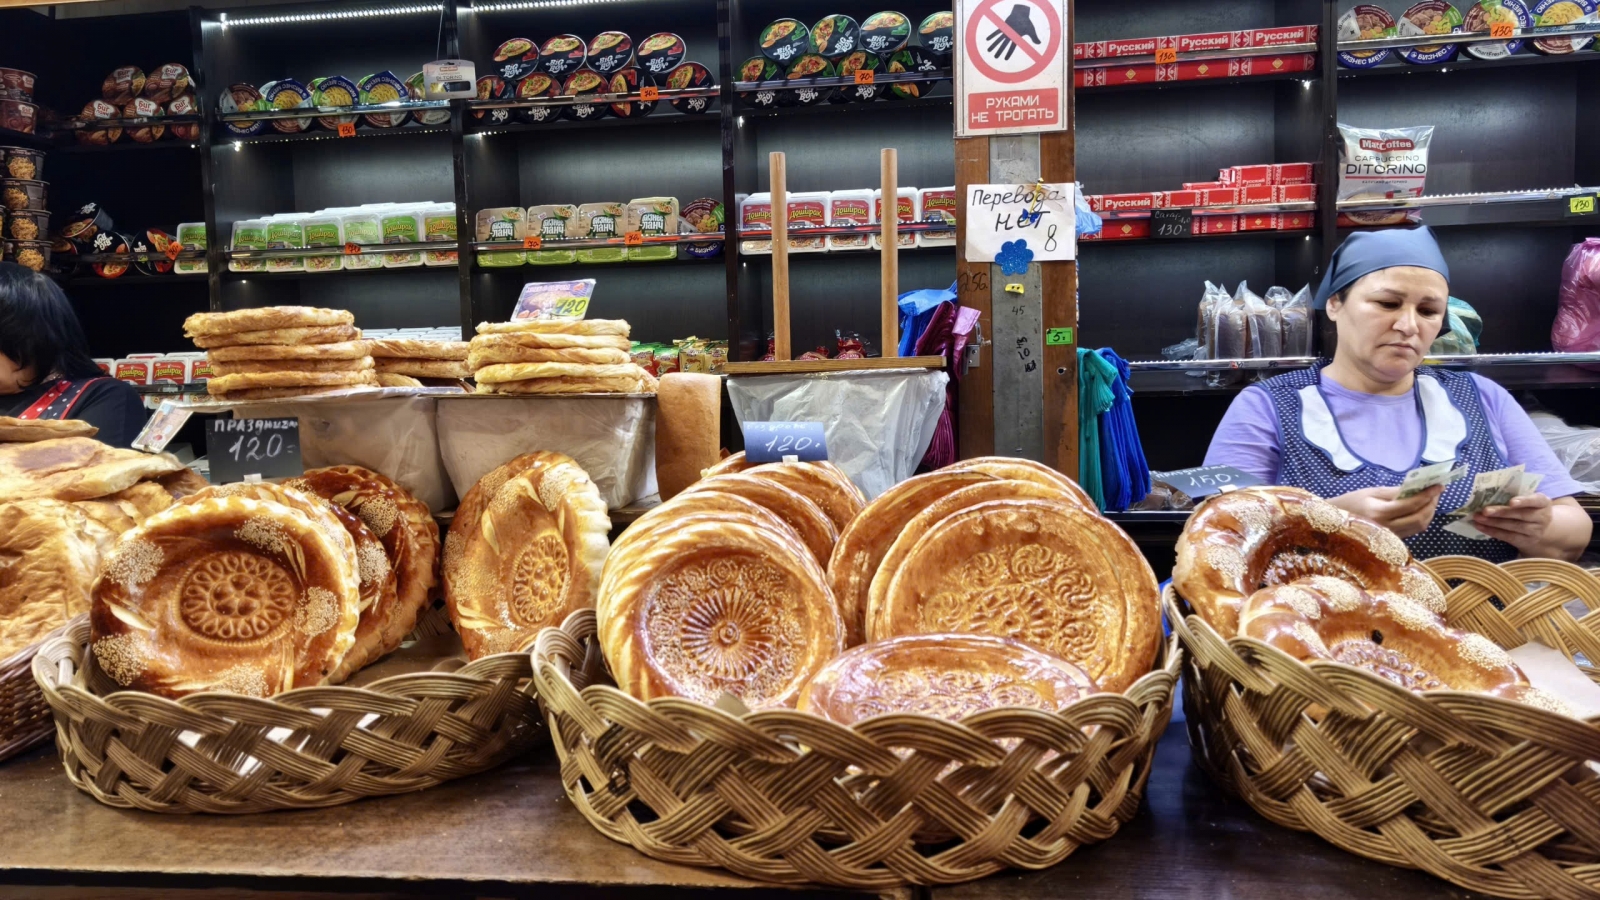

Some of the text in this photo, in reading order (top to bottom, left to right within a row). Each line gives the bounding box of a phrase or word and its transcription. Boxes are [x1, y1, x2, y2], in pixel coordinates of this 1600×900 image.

[1181, 35, 1229, 48] Русский
[1256, 29, 1304, 42] Русский
[1109, 41, 1155, 52] Русский
[1417, 49, 1448, 60] БИЗНЕС
[985, 95, 1040, 109] РУКАМИ
[971, 108, 1055, 123] НЕ ТРОГАТЬ
[1354, 155, 1420, 163] CAPPUCCINO
[1104, 197, 1151, 209] Русский
[745, 211, 772, 222] Дошира
[788, 209, 822, 221] Доширак
[834, 207, 867, 217] Доширак
[383, 224, 414, 236] Доширак
[1044, 224, 1058, 252] 8
[556, 299, 587, 314] 120
[1012, 305, 1026, 316] 45
[118, 369, 146, 378] Доширак
[154, 369, 183, 378] Доширак
